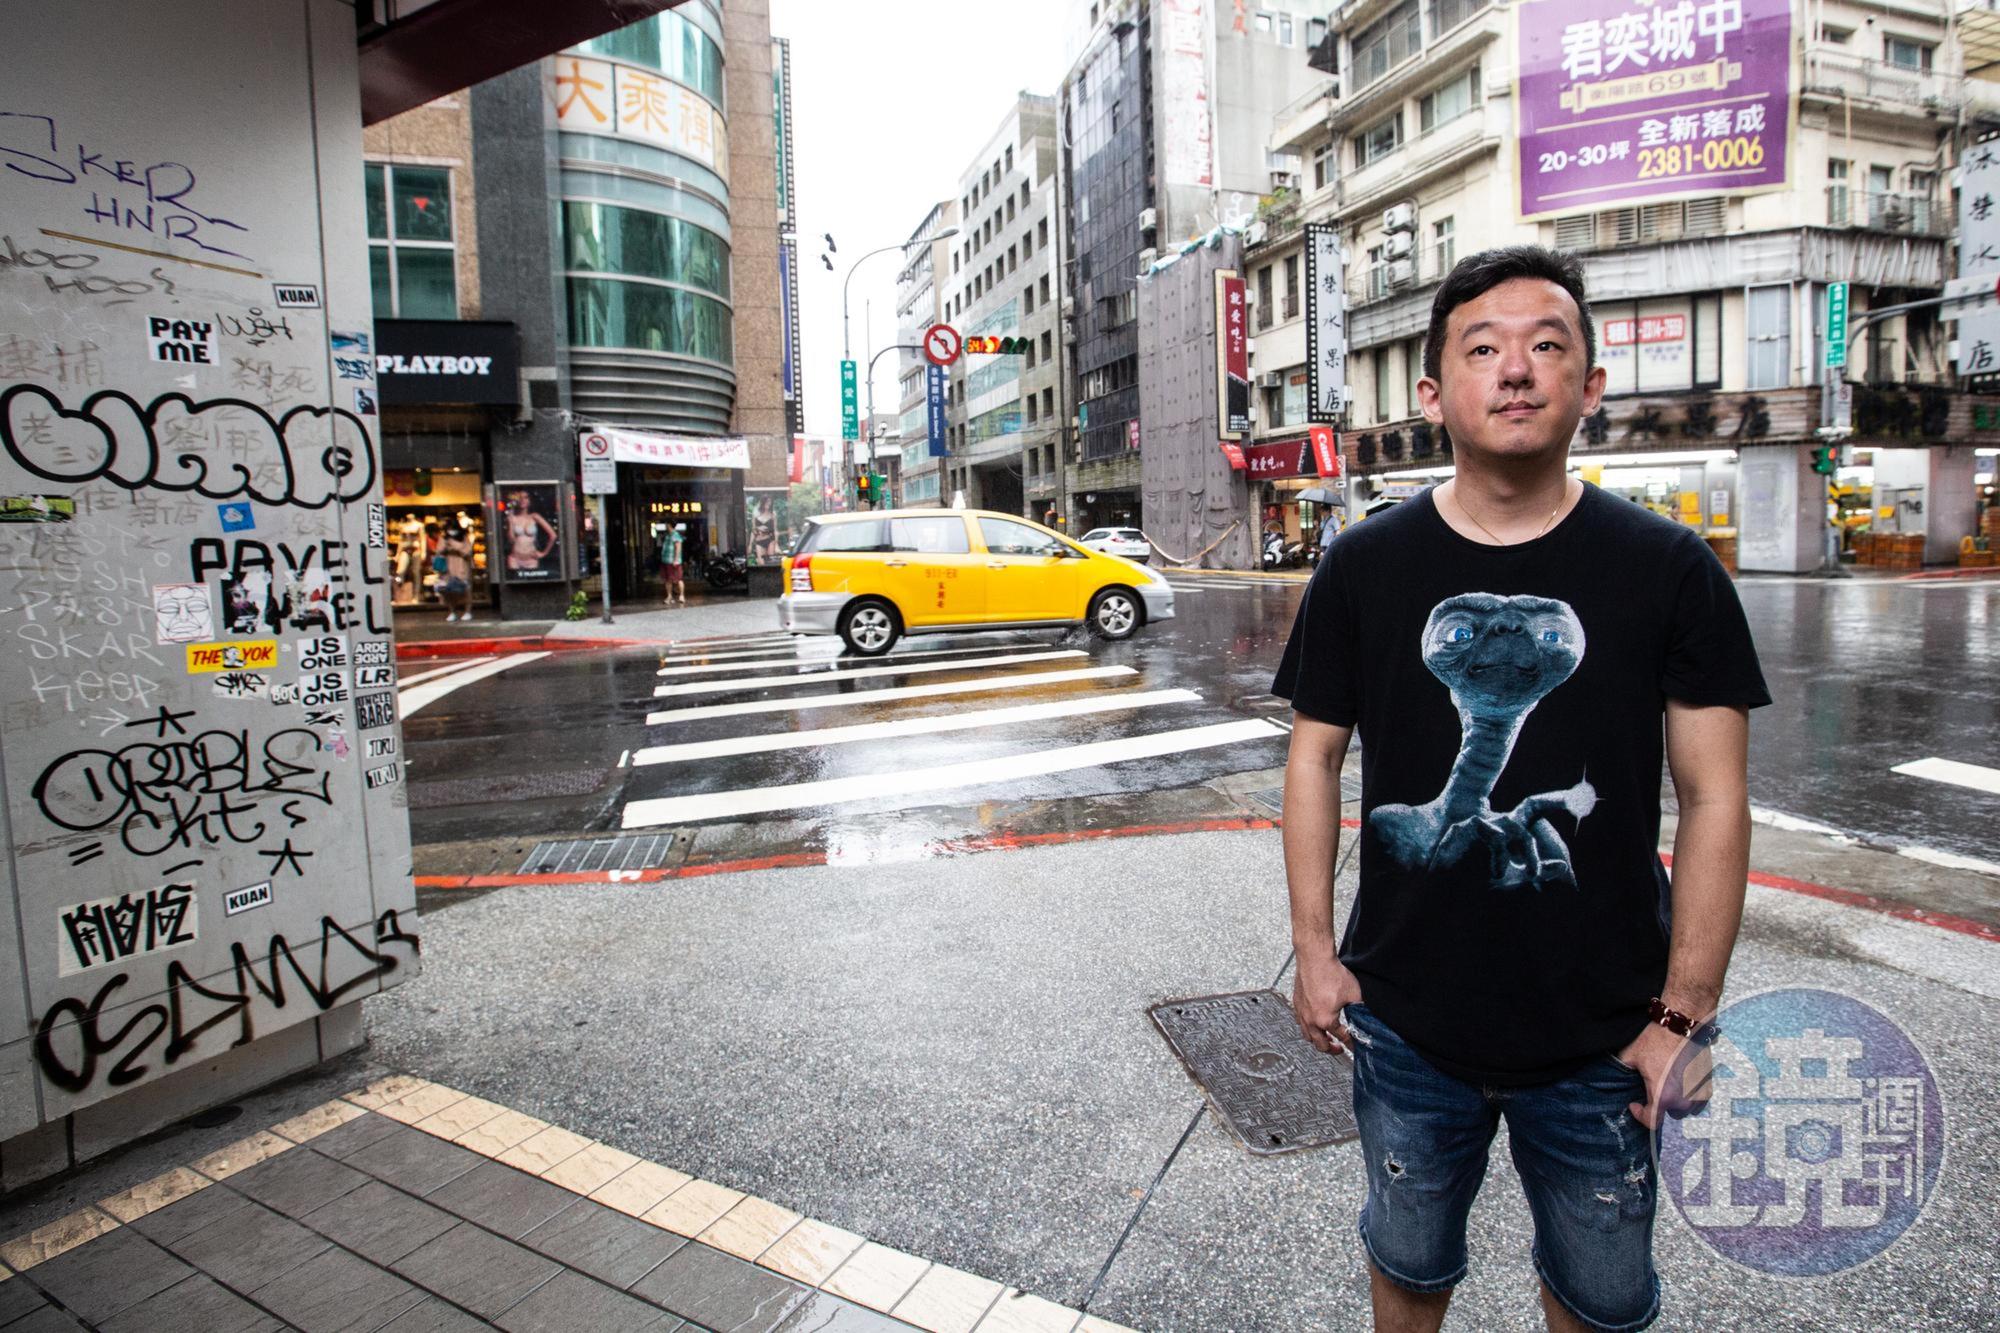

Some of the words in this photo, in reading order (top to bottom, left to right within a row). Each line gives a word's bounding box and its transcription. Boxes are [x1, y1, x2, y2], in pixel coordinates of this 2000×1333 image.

[1561, 0, 1742, 80] 君奕城中
[1638, 103, 1766, 147] 全新落成
[1538, 140, 1631, 173] 20-30坪
[1637, 136, 1764, 179] 2381-0006
[278, 290, 316, 303] KUAN
[150, 317, 212, 342] PAY
[158, 341, 212, 364] ME
[375, 355, 492, 375] PLAYBOY
[368, 504, 383, 547] ZEMOK
[189, 538, 385, 584] PAVEL
[17, 623, 165, 667] SKAR
[193, 649, 223, 665] THE
[242, 646, 273, 662] YOK
[305, 637, 340, 655] JS
[355, 642, 388, 653] ARDE
[300, 654, 347, 669] ONE
[306, 673, 342, 692] JS
[360, 668, 391, 684] LR
[302, 689, 348, 706] ONE
[360, 703, 393, 727] BARC
[229, 887, 269, 911] KUAN
